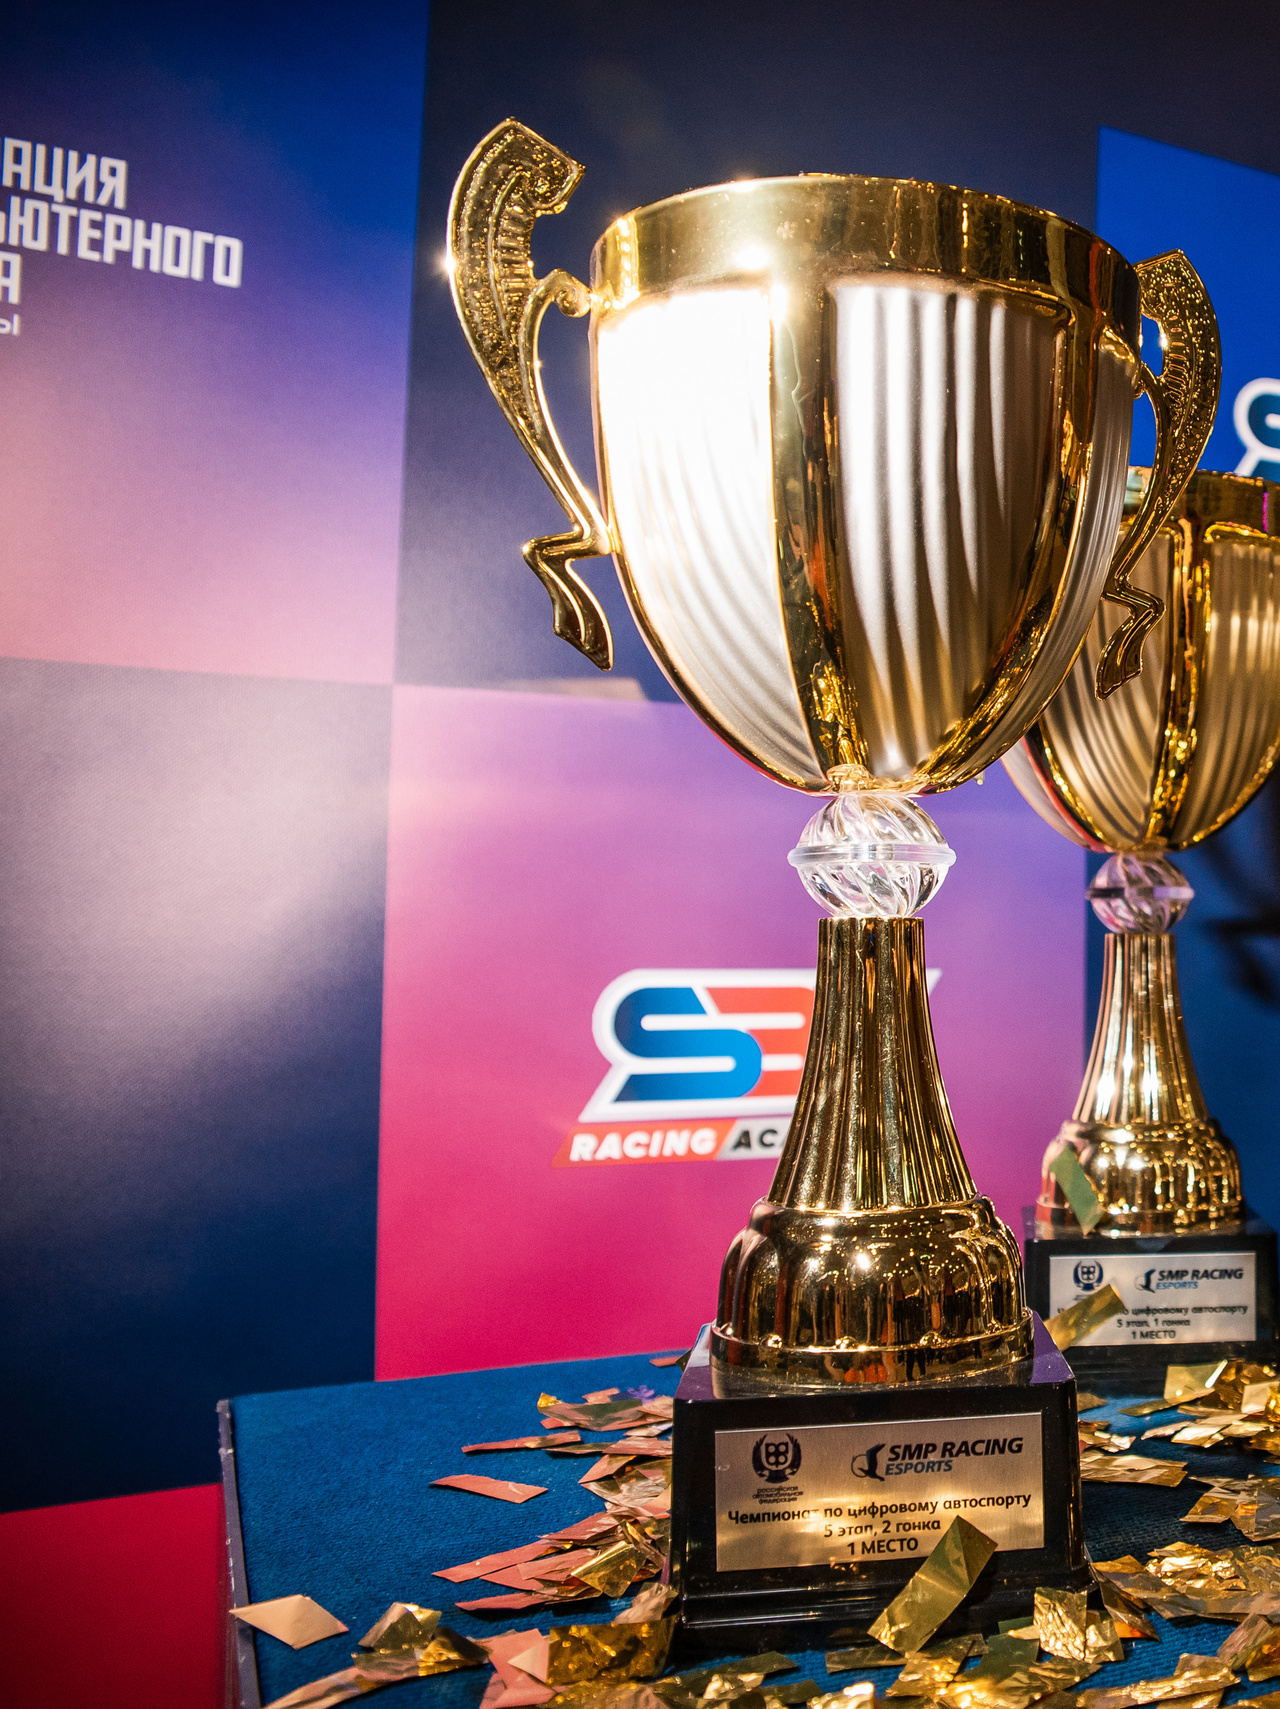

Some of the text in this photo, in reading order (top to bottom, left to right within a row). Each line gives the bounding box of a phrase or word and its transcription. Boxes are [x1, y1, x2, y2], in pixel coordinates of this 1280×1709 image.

[2, 136, 129, 211] АЦИЯ
[569, 1128, 786, 1162] RACING AC
[1158, 1268, 1244, 1281] SMP RACING
[1155, 1281, 1199, 1290] ESPORTS
[1116, 1319, 1123, 1328] 5
[1154, 1318, 1159, 1327] 1
[1132, 1330, 1177, 1340] 1 МЕСТО
[888, 1437, 1024, 1462] SMP RACING
[884, 1459, 953, 1476] ESPORTS
[824, 1507, 843, 1518] по
[847, 1501, 939, 1519] цифровому
[943, 1493, 1032, 1509] автоспорту
[823, 1519, 941, 1538] 5 этап, 2 гонка
[847, 1537, 919, 1556] 1 МЕСТО
